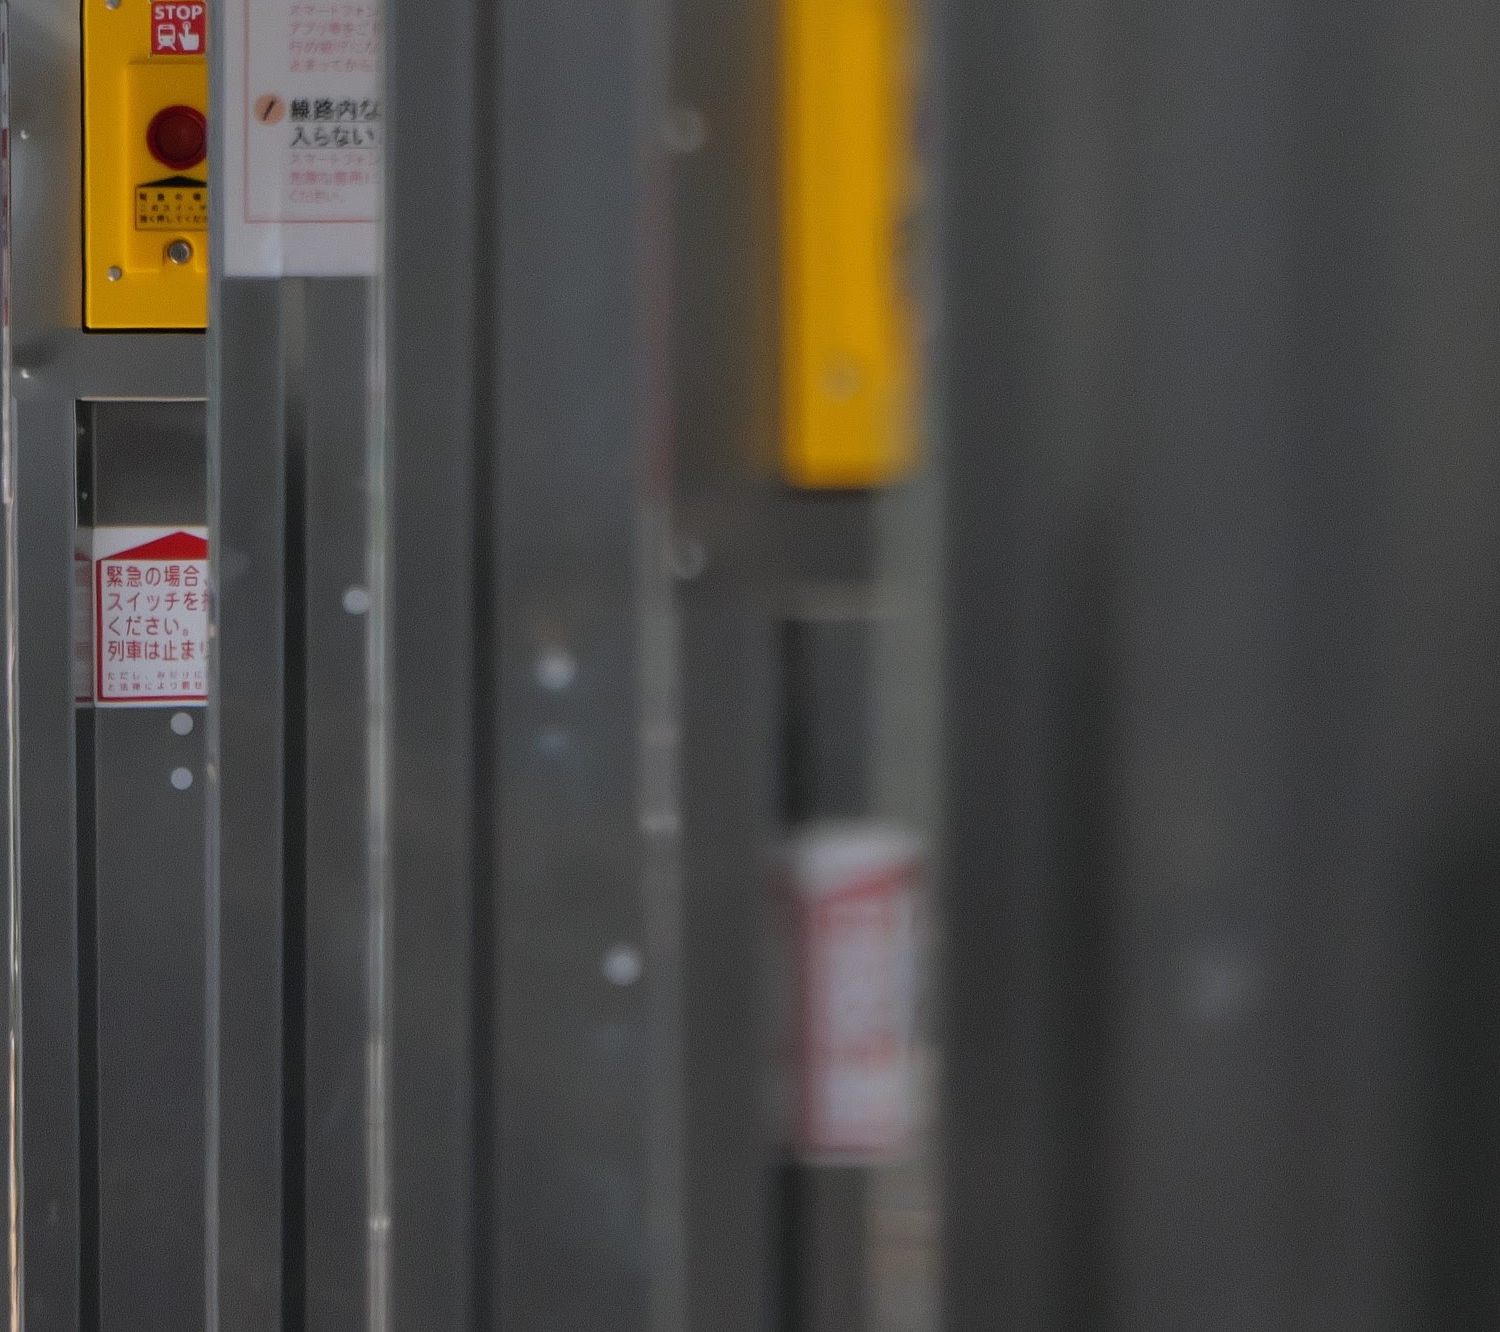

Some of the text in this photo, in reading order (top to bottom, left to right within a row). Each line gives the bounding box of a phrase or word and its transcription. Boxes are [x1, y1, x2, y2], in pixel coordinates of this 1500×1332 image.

[154, 5, 203, 21] STOP
[107, 615, 190, 637] ください。
